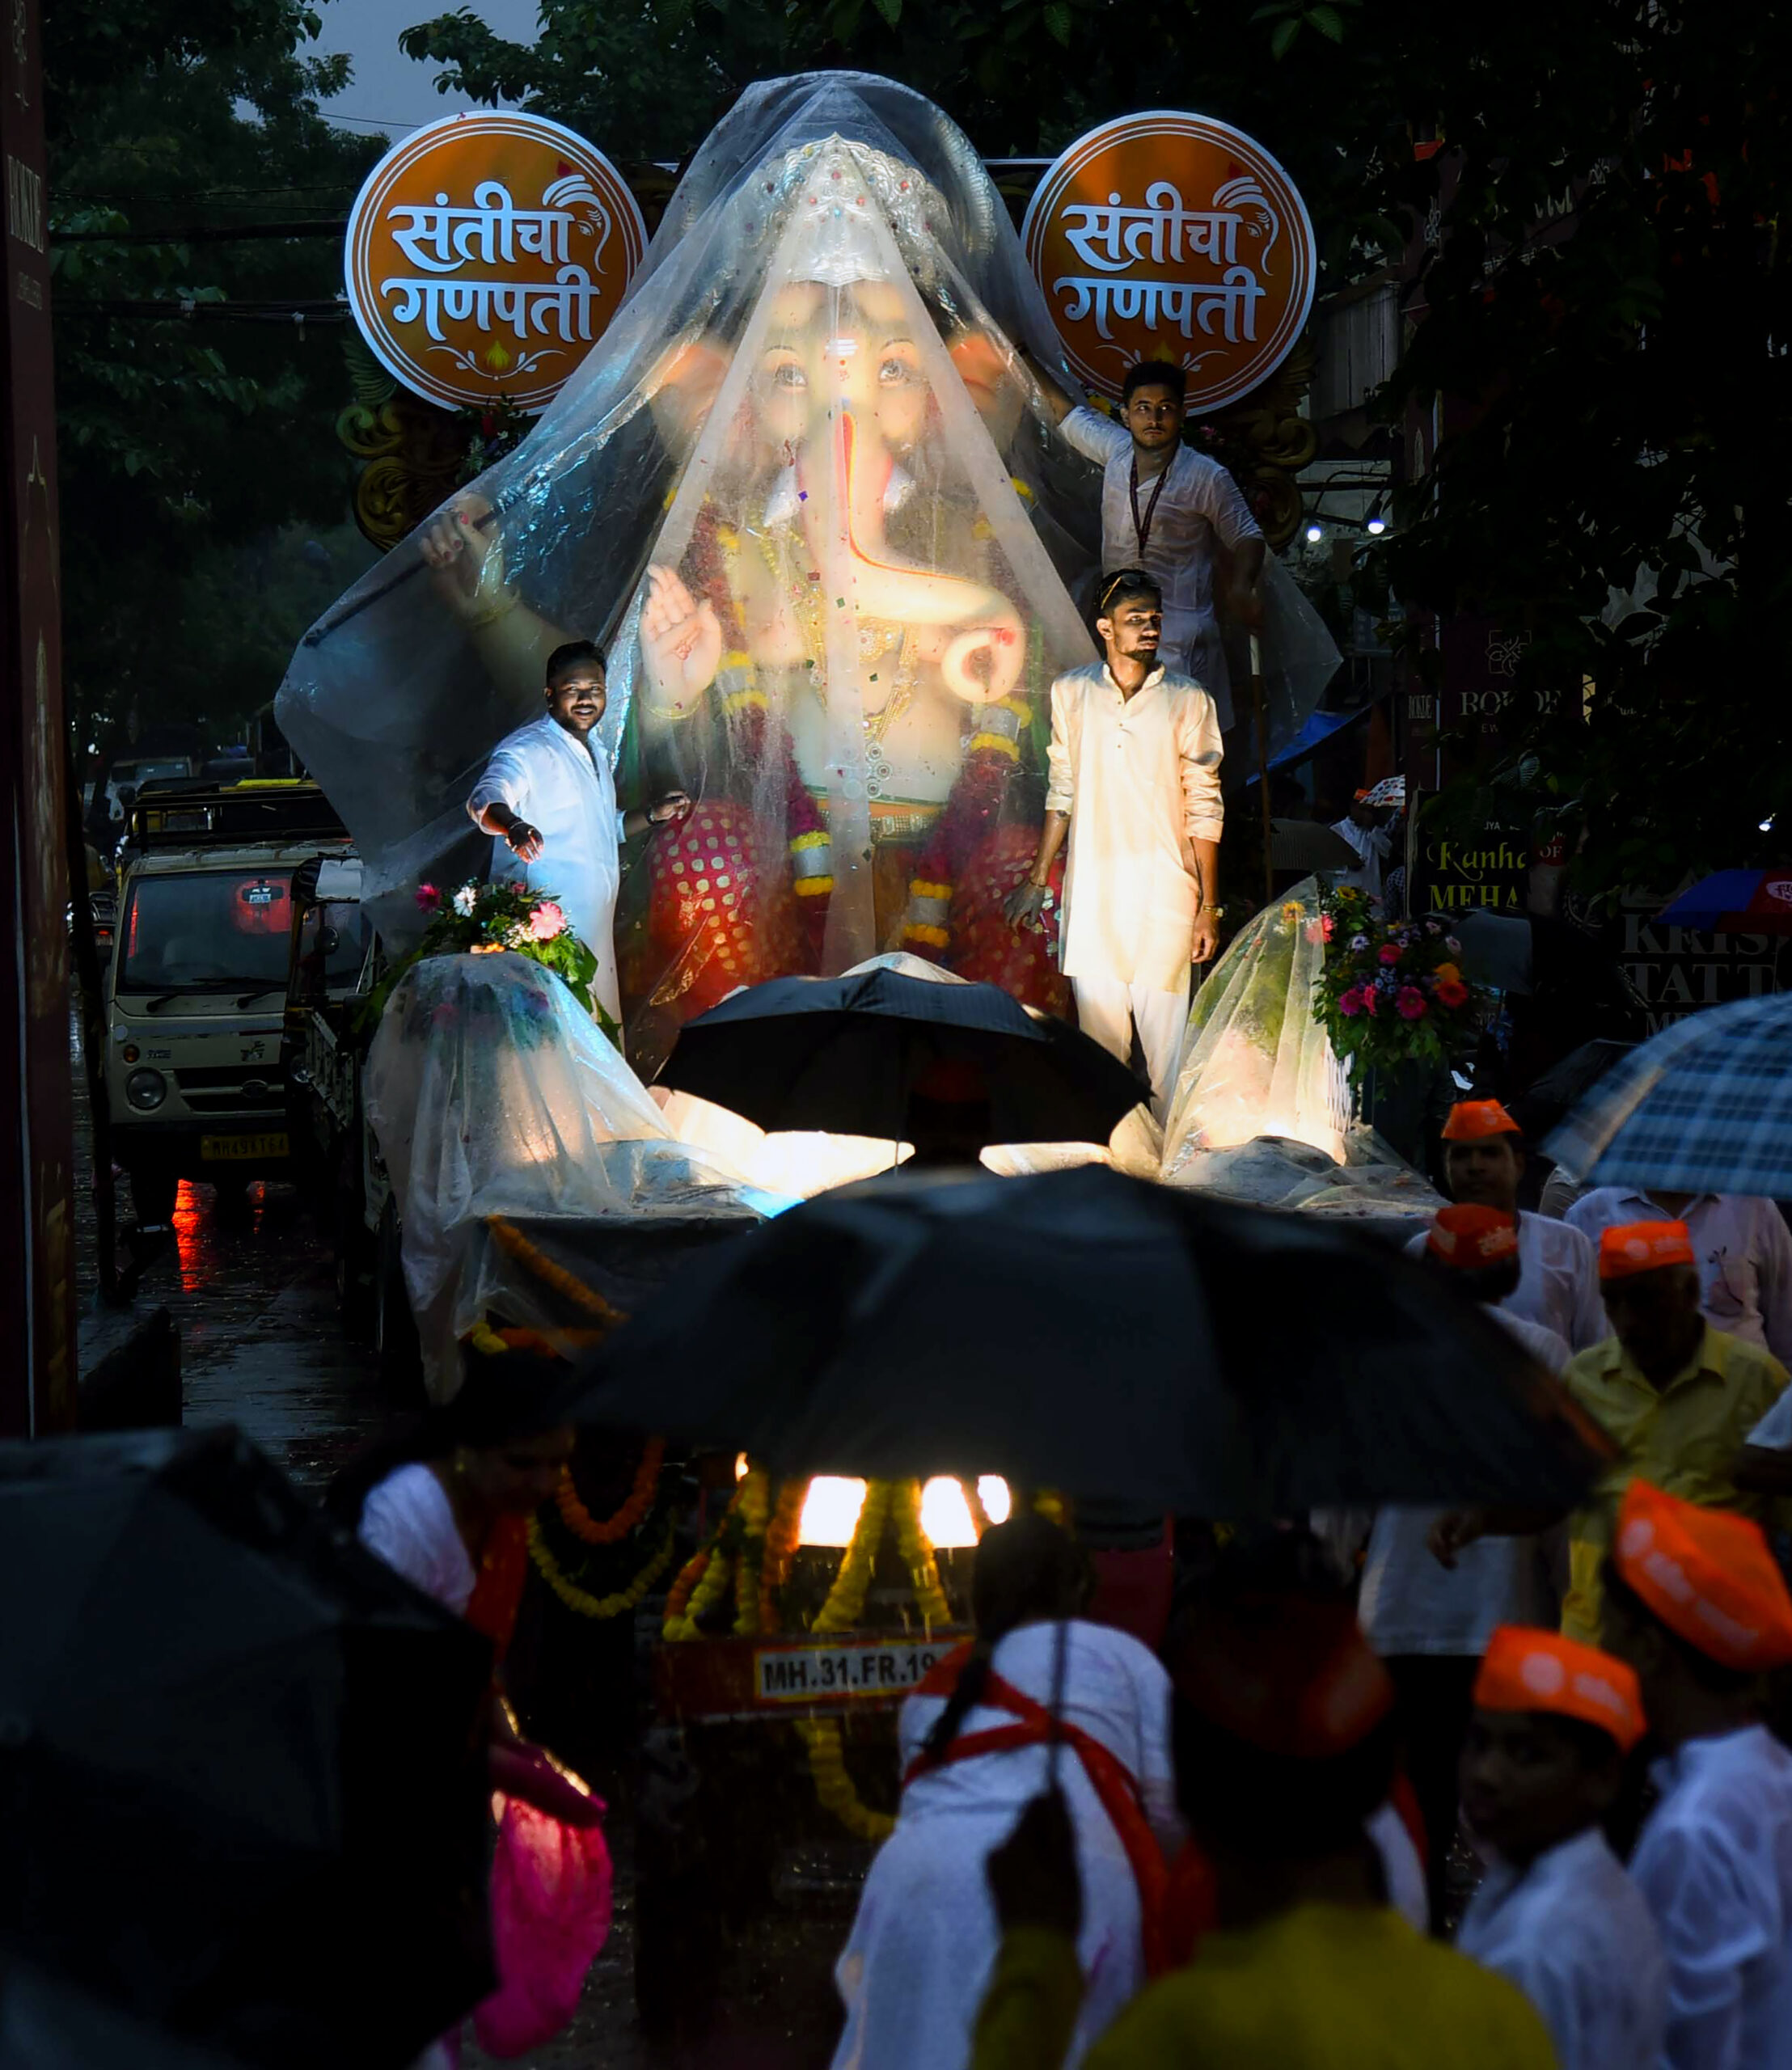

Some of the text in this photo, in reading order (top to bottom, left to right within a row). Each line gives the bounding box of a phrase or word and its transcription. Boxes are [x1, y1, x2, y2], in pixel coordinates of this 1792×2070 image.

[387, 181, 576, 272] संतीचा
[1061, 181, 1244, 272] संतीचा
[381, 264, 600, 343] गणपती
[1053, 266, 1266, 344] गणपती
